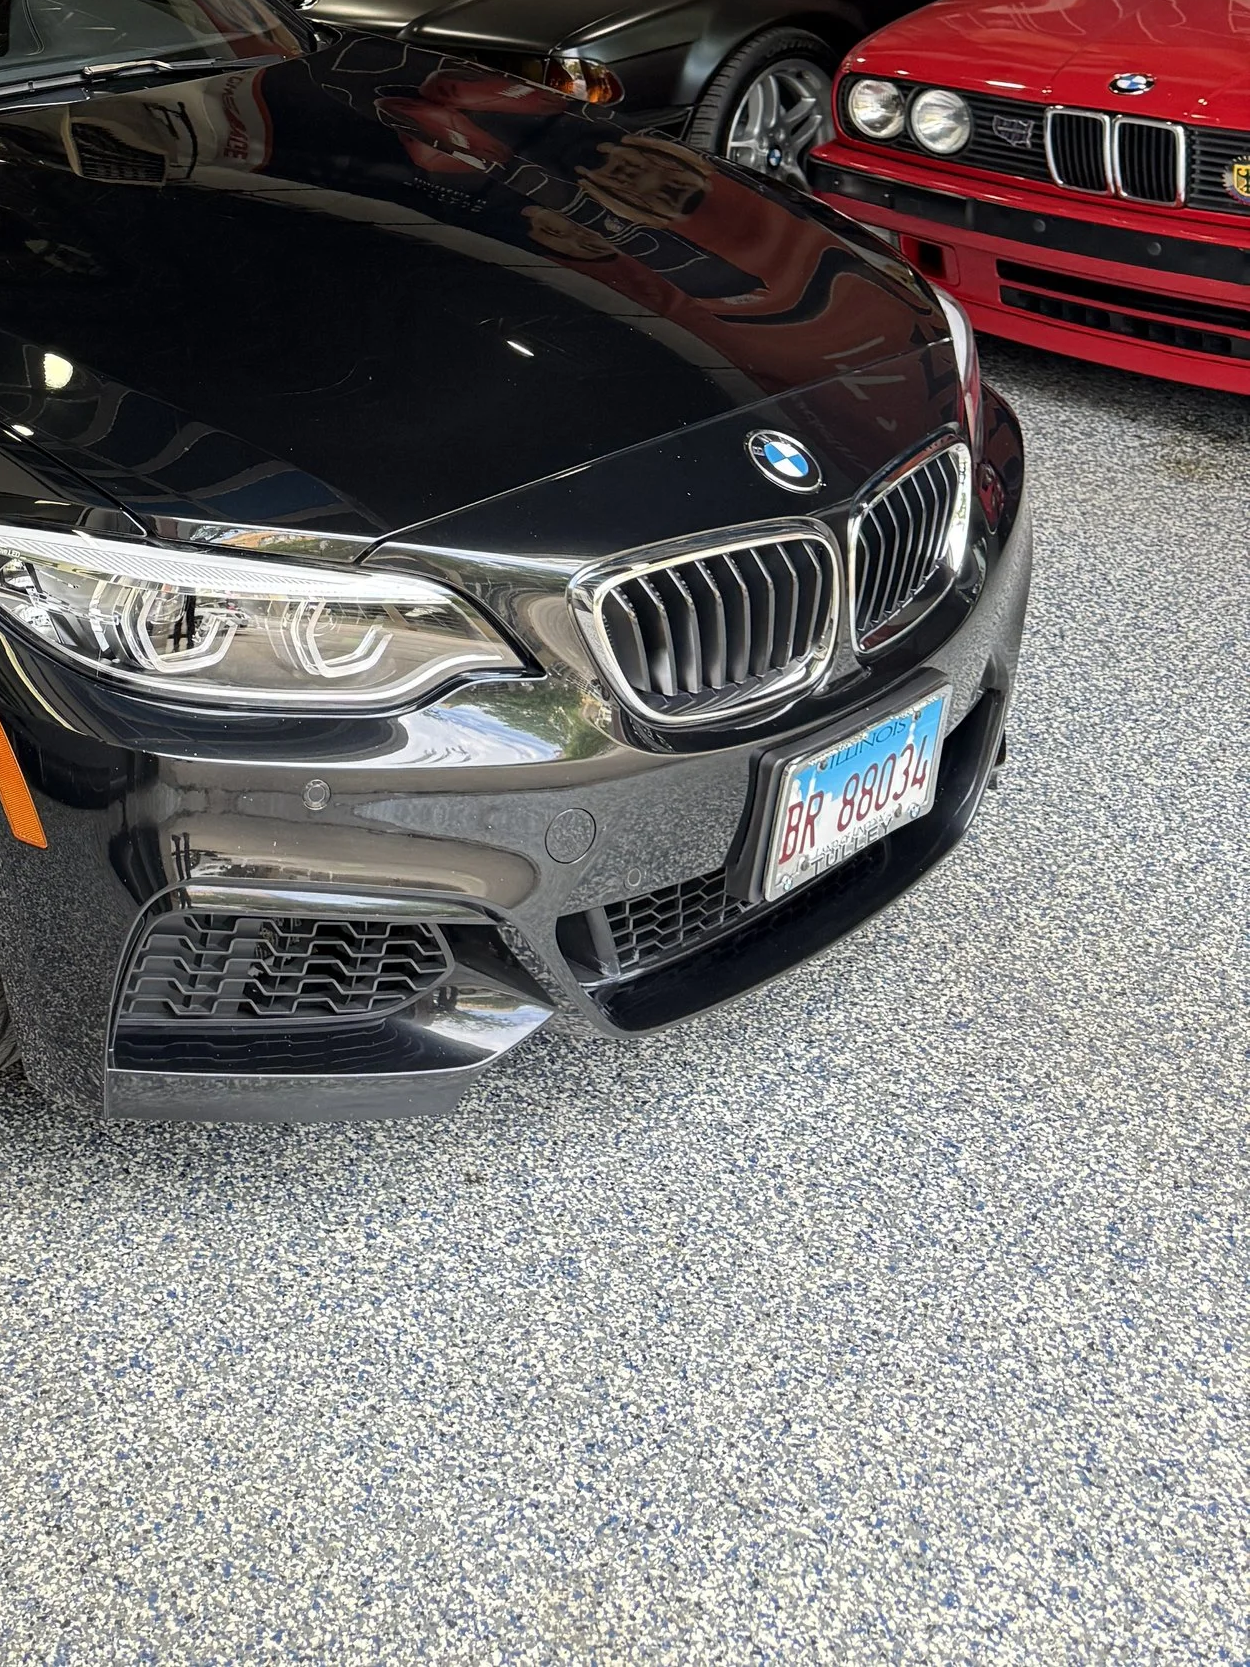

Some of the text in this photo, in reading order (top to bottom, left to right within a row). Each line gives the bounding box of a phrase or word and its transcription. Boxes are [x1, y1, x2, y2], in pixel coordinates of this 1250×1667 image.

[8, 549, 21, 558] LED
[828, 720, 907, 769] ILLINOIS
[778, 735, 929, 865] BR 88034
[811, 817, 893, 876] TULLEY
